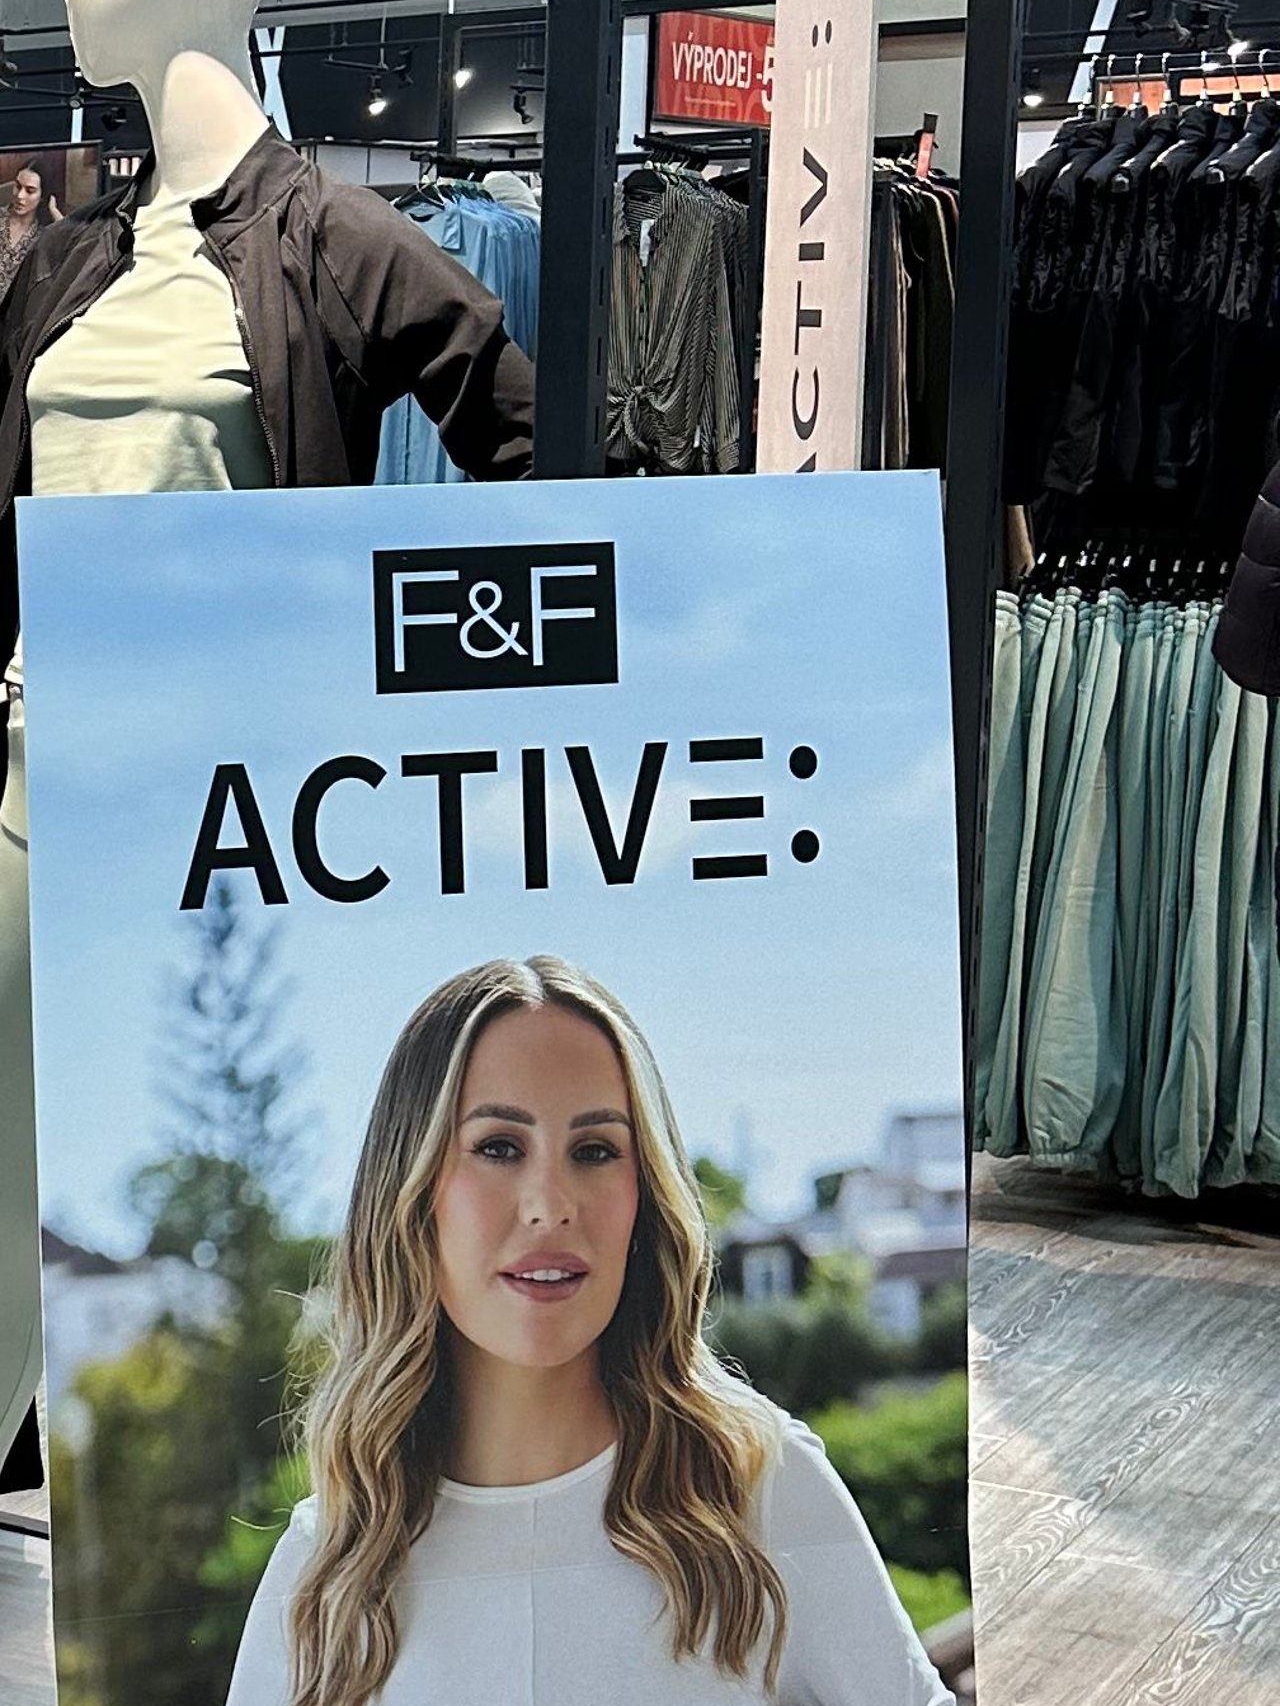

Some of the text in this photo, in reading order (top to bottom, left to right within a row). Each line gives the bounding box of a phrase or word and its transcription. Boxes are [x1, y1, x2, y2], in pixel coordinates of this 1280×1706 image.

[672, 31, 753, 90] VÝPRODEJ
[391, 564, 598, 673] F&F
[178, 736, 821, 911] ACTIVE:
